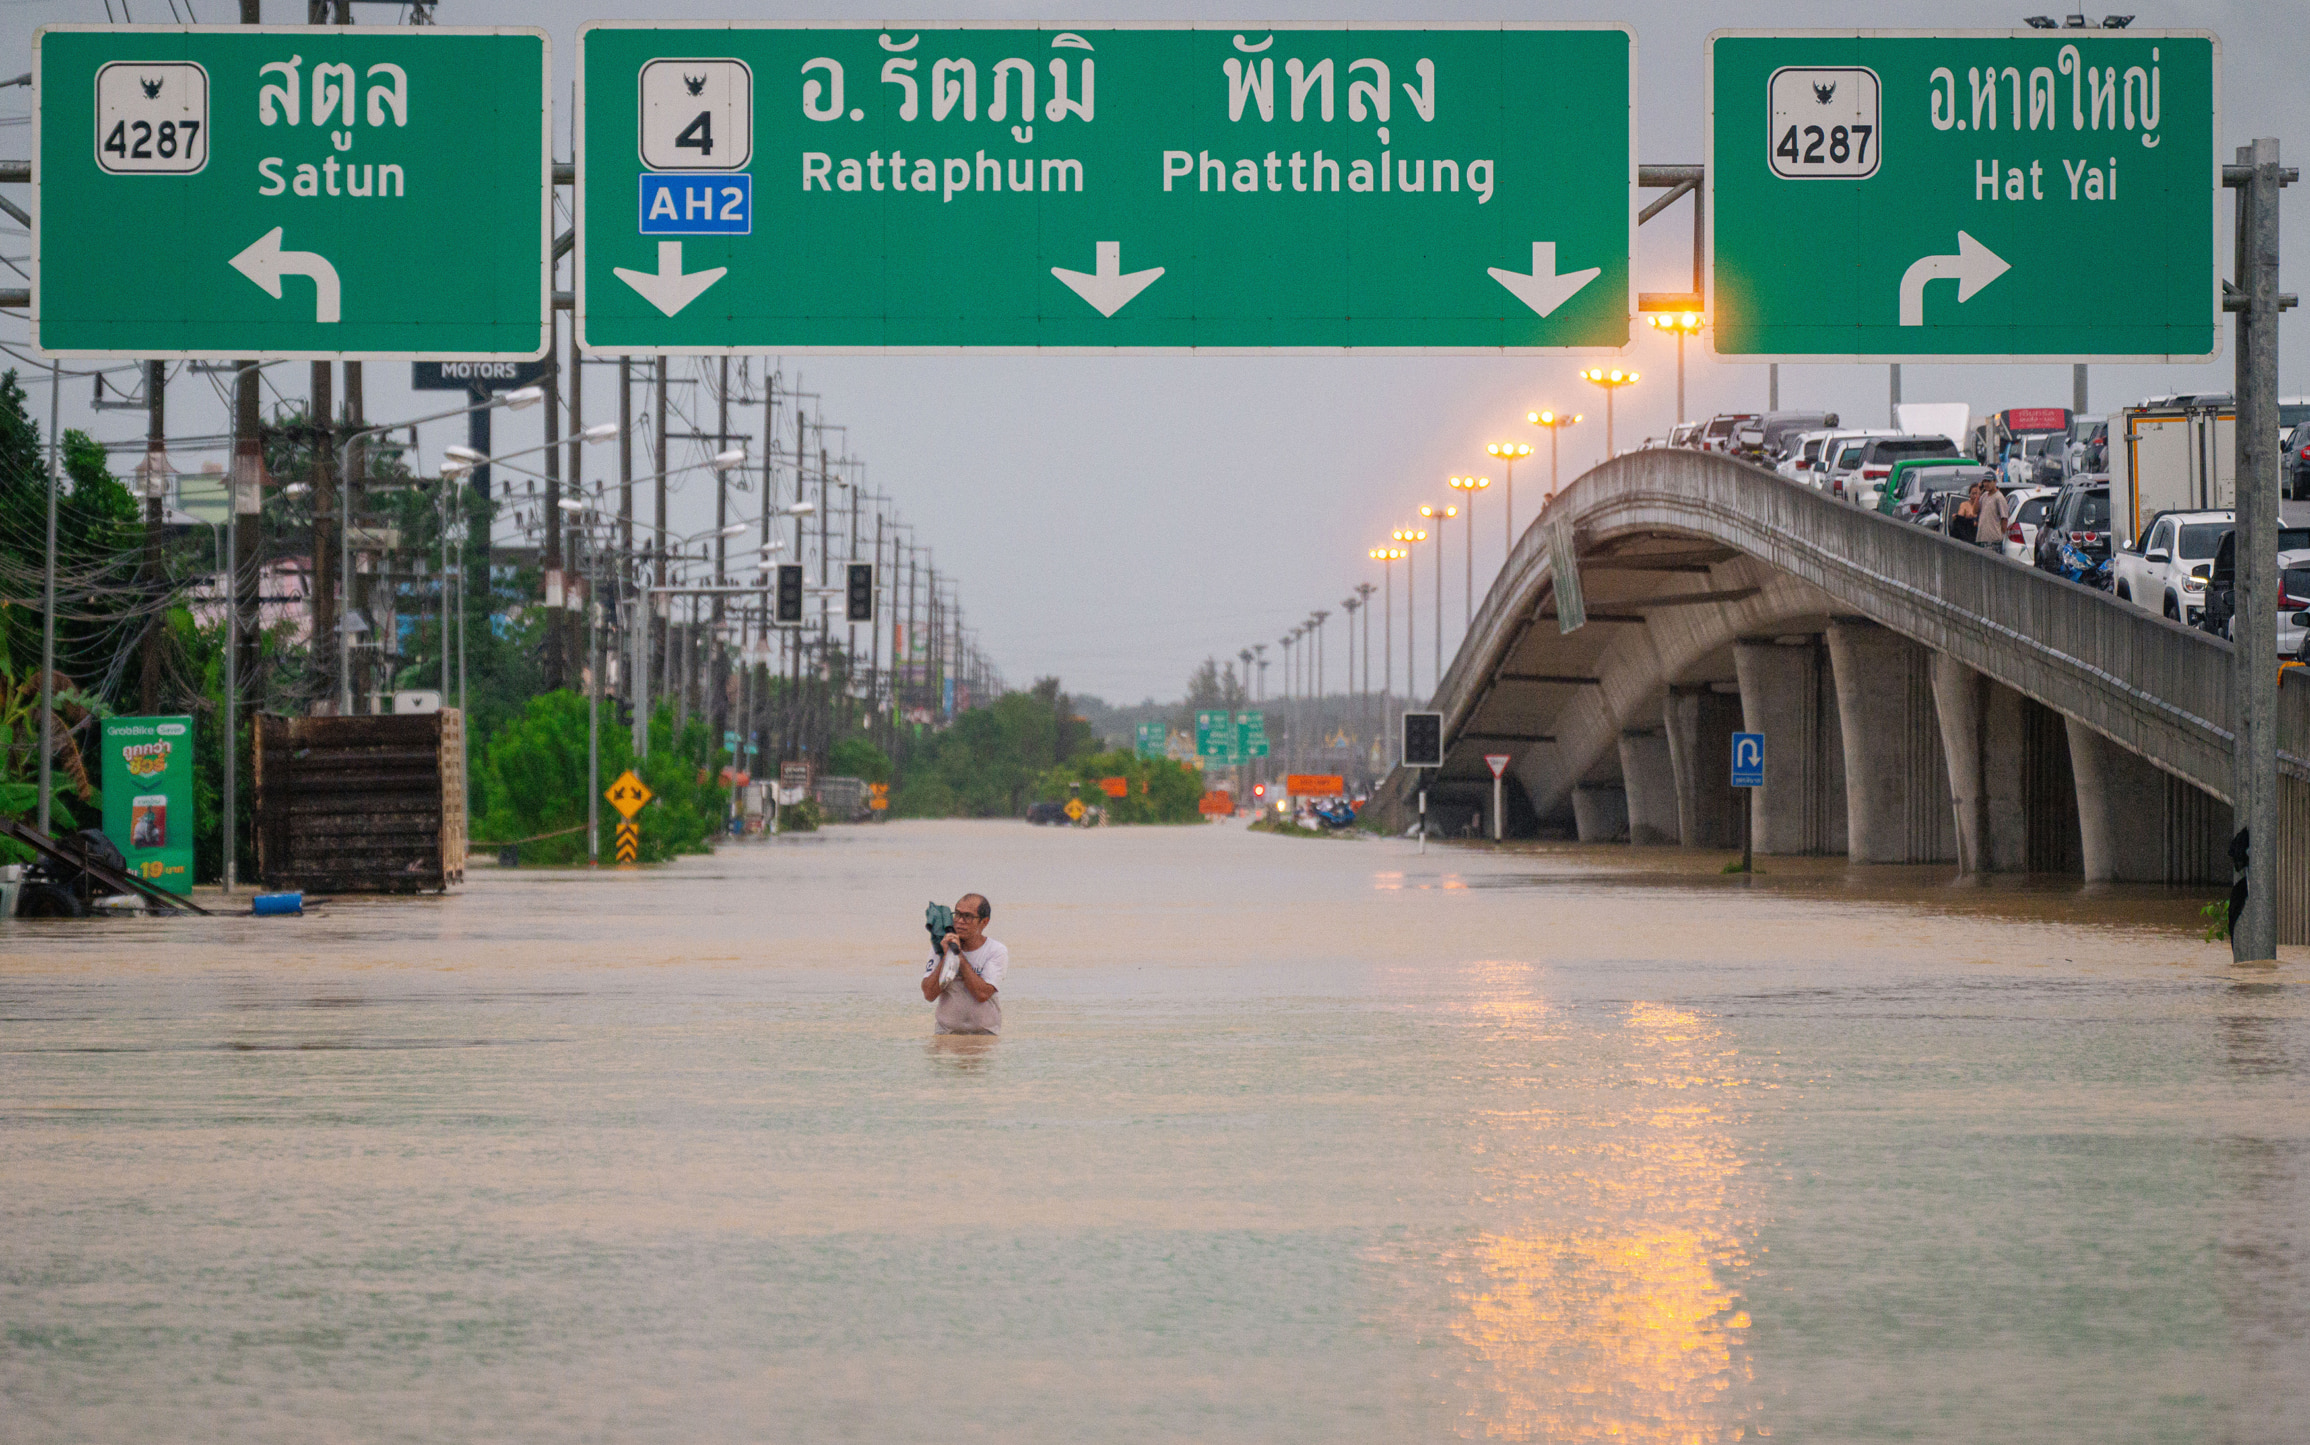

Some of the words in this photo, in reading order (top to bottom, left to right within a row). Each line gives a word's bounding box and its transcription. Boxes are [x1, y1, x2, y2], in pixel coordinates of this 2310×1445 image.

[259, 55, 408, 151] สตูล
[801, 57, 864, 122] อ.
[879, 33, 1096, 143] รัตภูมิ
[1222, 34, 1435, 145] พัทลุง
[1930, 45, 2161, 147] อ.หาดใหญ่
[104, 120, 201, 159] 4287
[675, 110, 714, 156] 4
[1776, 125, 1873, 164] 4287
[258, 156, 405, 197] Satun
[802, 150, 1084, 203] Rattaphum
[1163, 150, 1495, 204] Phatthalung
[1976, 159, 2044, 200] Hat
[2062, 157, 2118, 201] Yai
[648, 187, 744, 221] AH2
[441, 362, 517, 378] MOTORS
[107, 726, 154, 736] GrabBike
[140, 861, 164, 879] 19
